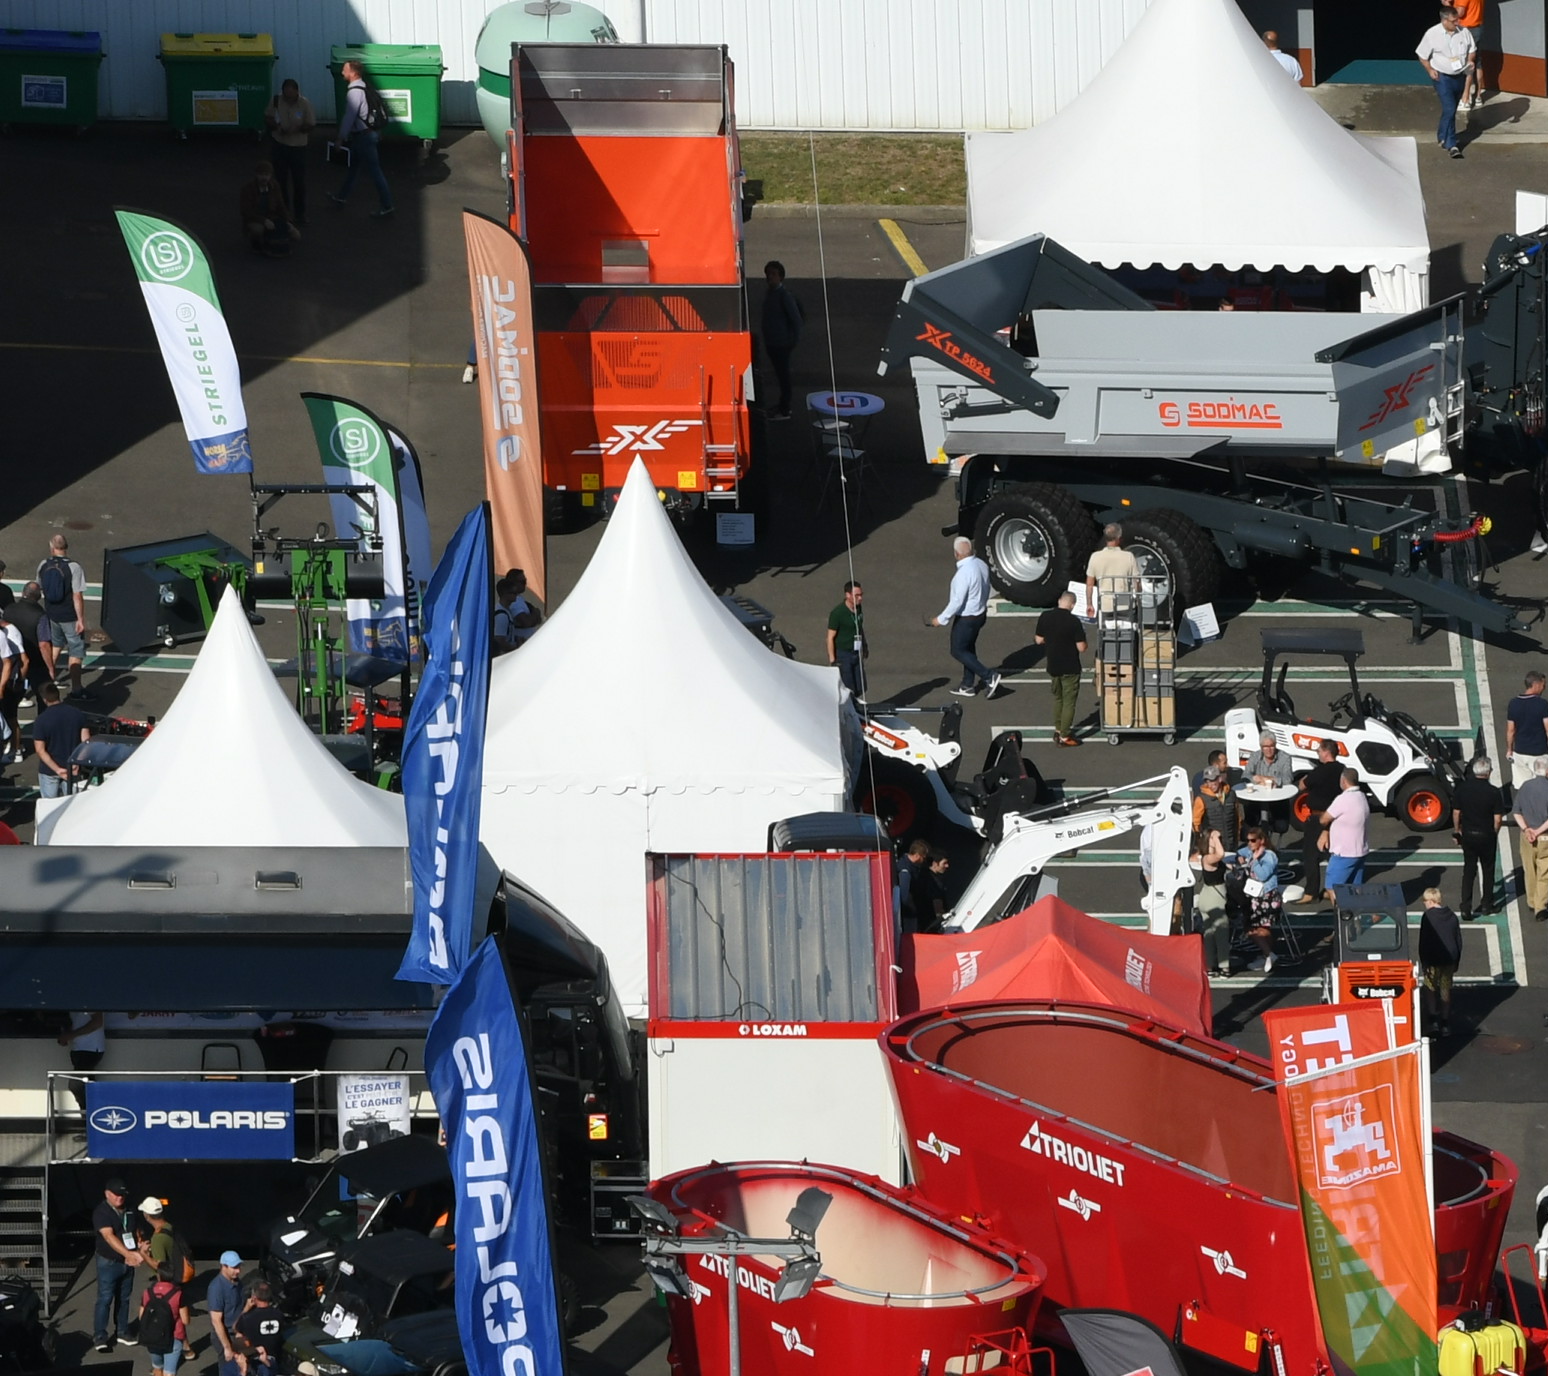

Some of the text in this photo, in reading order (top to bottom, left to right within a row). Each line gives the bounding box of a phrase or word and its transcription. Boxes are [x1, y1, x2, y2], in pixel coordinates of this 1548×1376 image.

[962, 350, 993, 377] 5624
[187, 322, 228, 427] STRIEGEL
[1187, 397, 1281, 421] SODIMAC
[1067, 825, 1094, 839] Bobcat
[753, 1024, 807, 1036] LOXAM
[344, 1081, 402, 1094] L'ESSAYER
[344, 1097, 403, 1109] LE GAGNER
[144, 1109, 287, 1130] POLARIS
[1037, 1133, 1125, 1187] TRIOLIET
